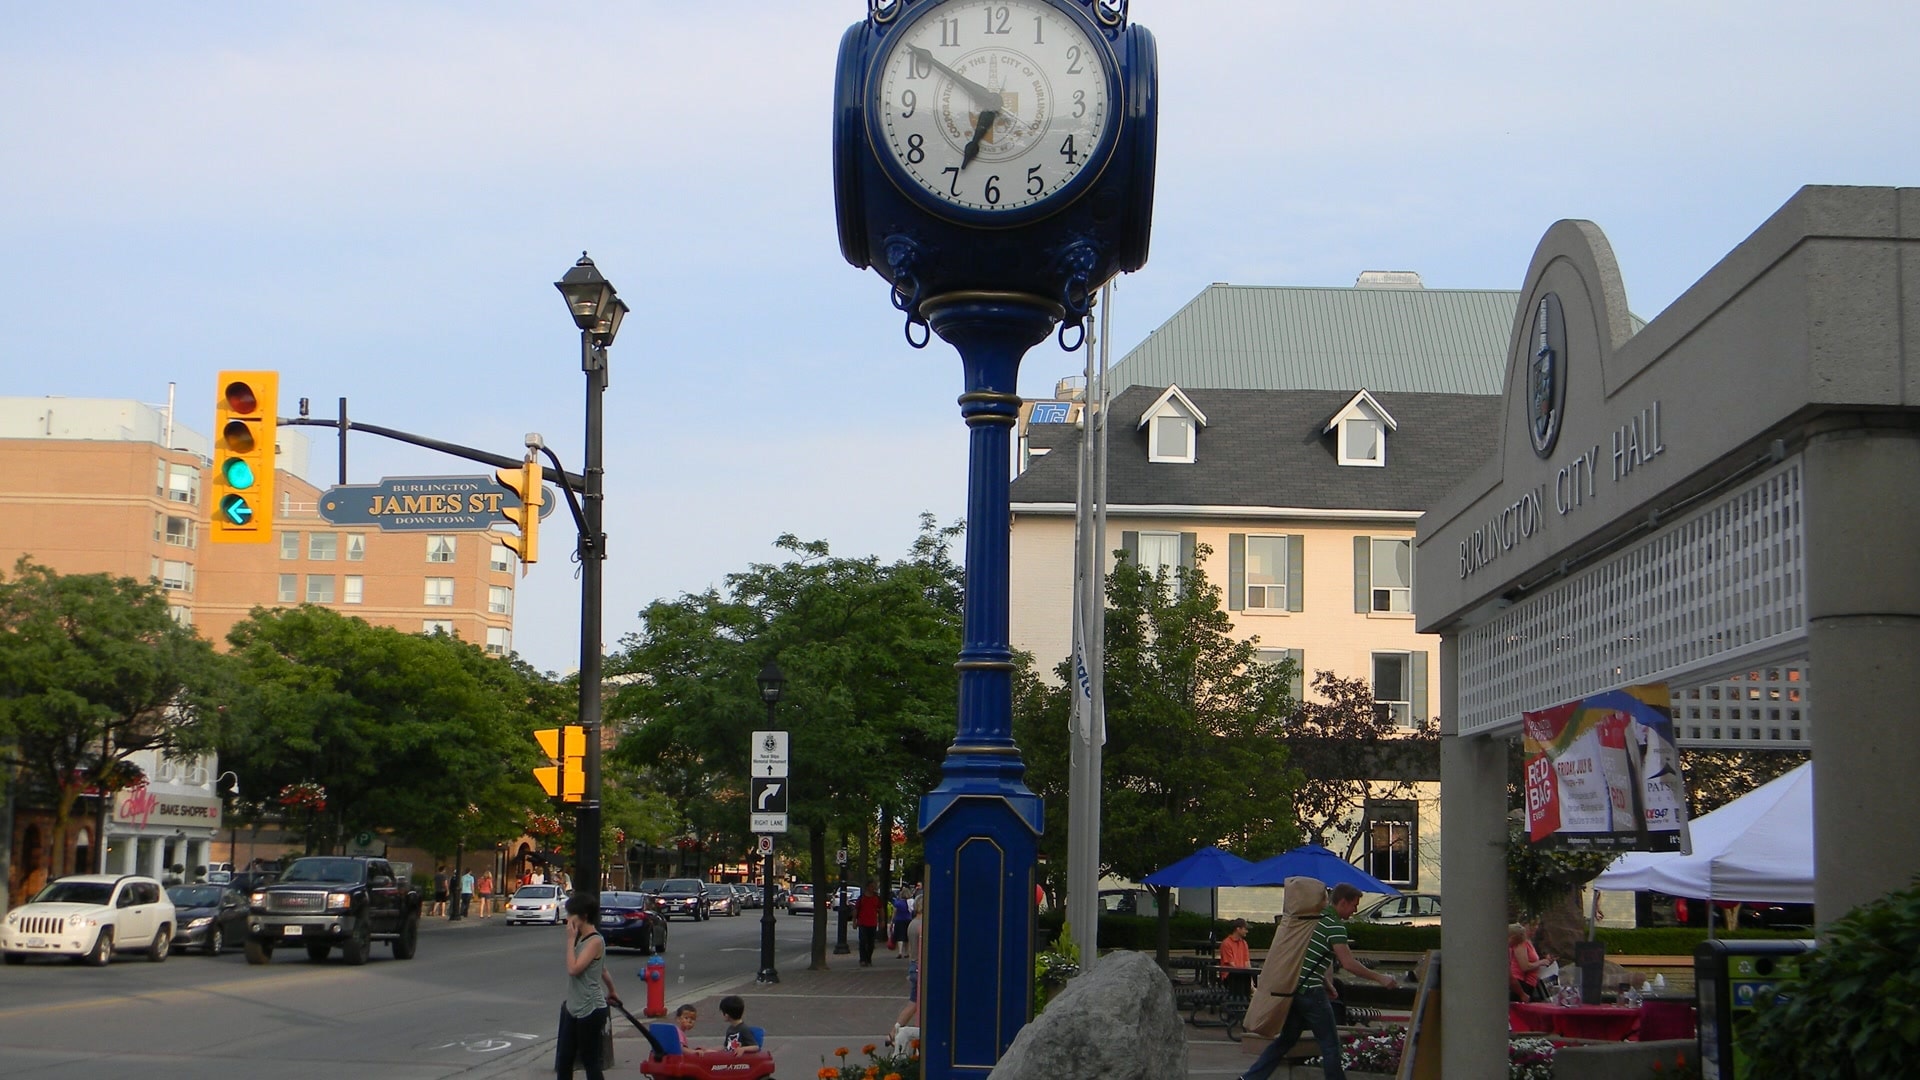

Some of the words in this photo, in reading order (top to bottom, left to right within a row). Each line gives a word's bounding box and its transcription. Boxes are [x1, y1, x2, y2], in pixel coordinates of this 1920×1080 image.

[939, 18, 961, 47] 11
[983, 6, 1013, 35] 12
[1033, 16, 1045, 44] 1
[906, 50, 933, 80] 10
[1066, 45, 1085, 75] 2
[901, 89, 917, 118] 9
[943, 80, 961, 138] CORPORATIO
[968, 56, 987, 67] THE
[1001, 56, 1022, 68] CITY
[1022, 67, 1034, 77] OF
[1072, 89, 1086, 118] 3
[907, 134, 925, 164] 8
[1060, 134, 1077, 164] 4
[941, 167, 963, 197] 7
[984, 175, 1000, 204] 6
[1026, 164, 1044, 195] 5
[392, 484, 479, 492] BURLINGTON
[1459, 483, 1546, 579] BURLINGTON
[1555, 445, 1600, 515] CITY
[1612, 400, 1665, 481] HALL
[368, 494, 463, 516] JAMES
[468, 493, 503, 513] ST
[395, 515, 476, 524] DOWNTOWN
[1528, 757, 1549, 787] RED
[1530, 780, 1551, 811] BAG
[160, 804, 179, 816] BAKE
[180, 805, 208, 818] SHOPPE
